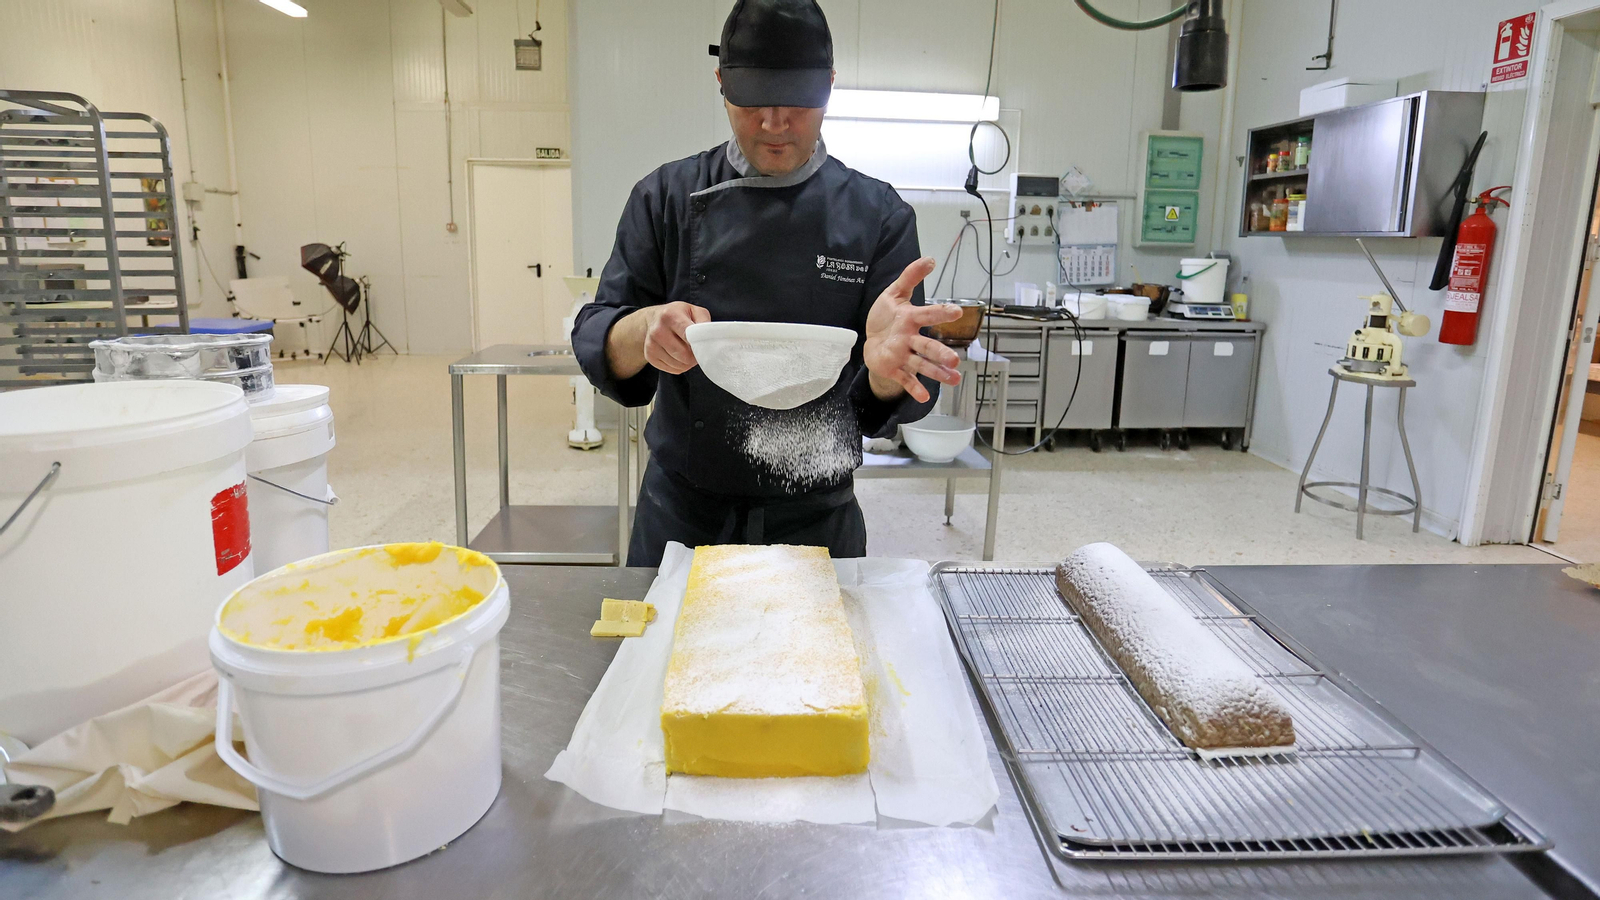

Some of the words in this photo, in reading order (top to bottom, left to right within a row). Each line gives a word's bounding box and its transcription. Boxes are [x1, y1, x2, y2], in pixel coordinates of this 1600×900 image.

[1496, 63, 1523, 75] EXTINTOR
[537, 149, 560, 158] SALIDA
[820, 272, 837, 280] Daniel
